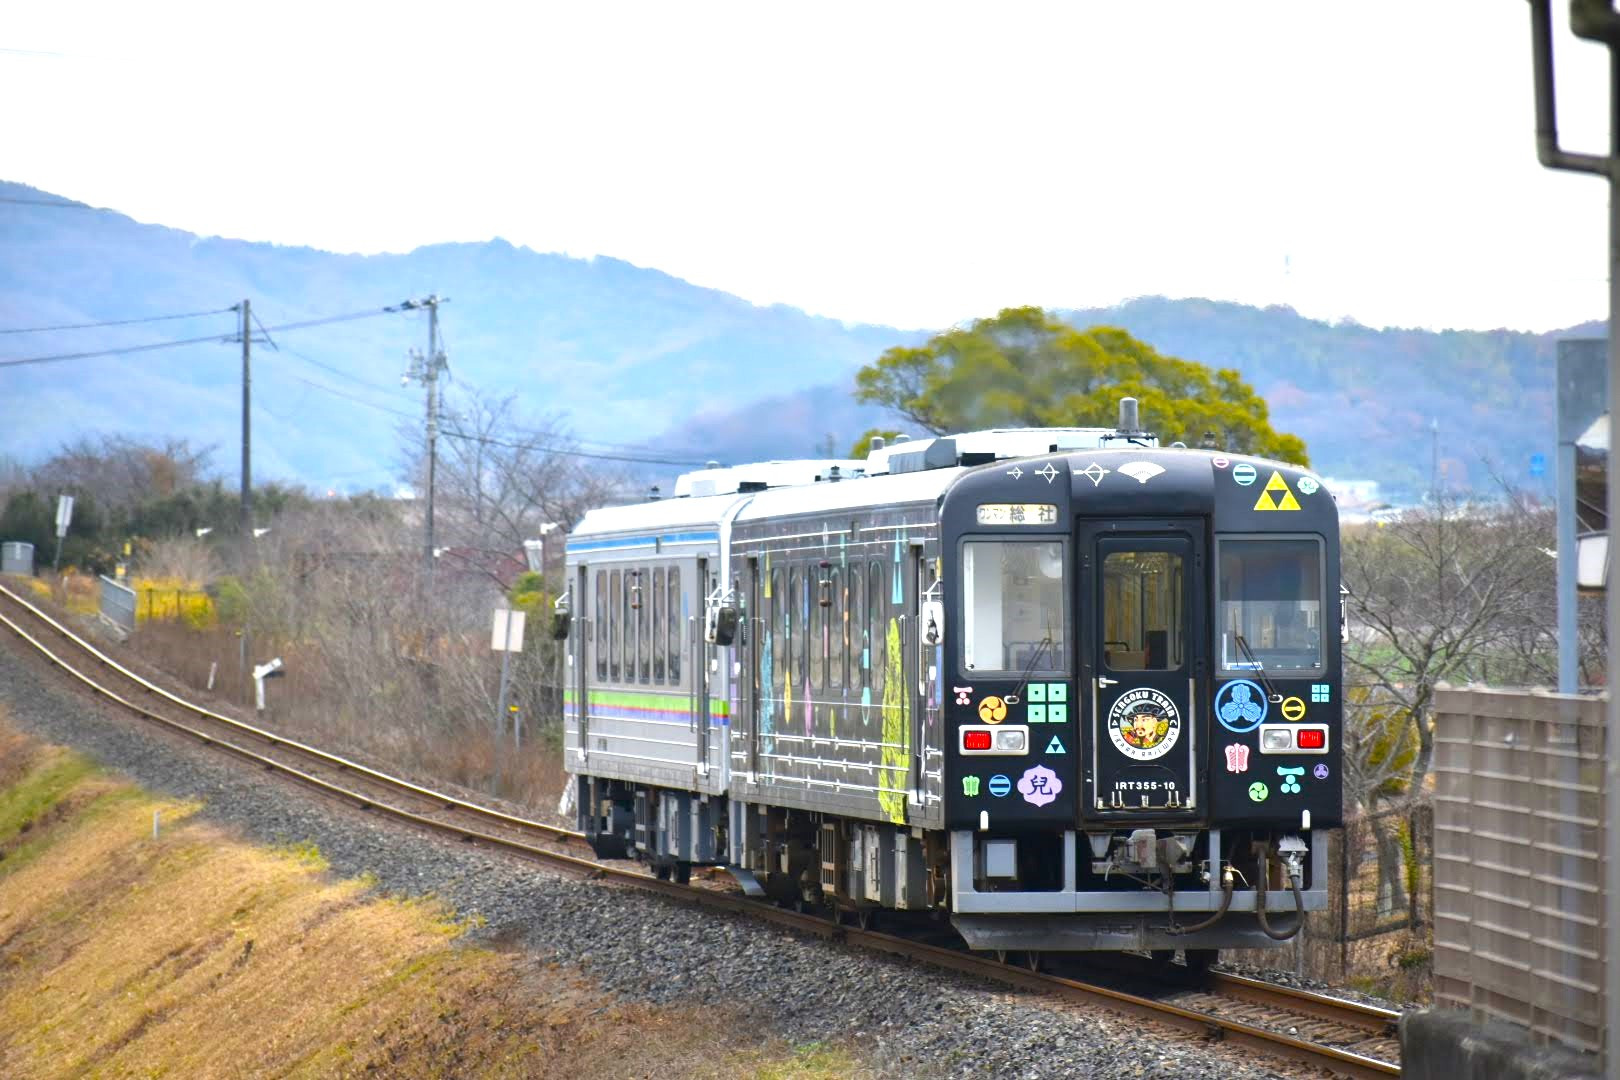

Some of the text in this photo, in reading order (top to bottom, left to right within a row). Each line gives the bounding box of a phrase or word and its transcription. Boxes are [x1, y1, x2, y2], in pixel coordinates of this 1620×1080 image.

[1112, 691, 1175, 718] SENGOKU TRAIN
[1115, 781, 1176, 790] IRT355-10
